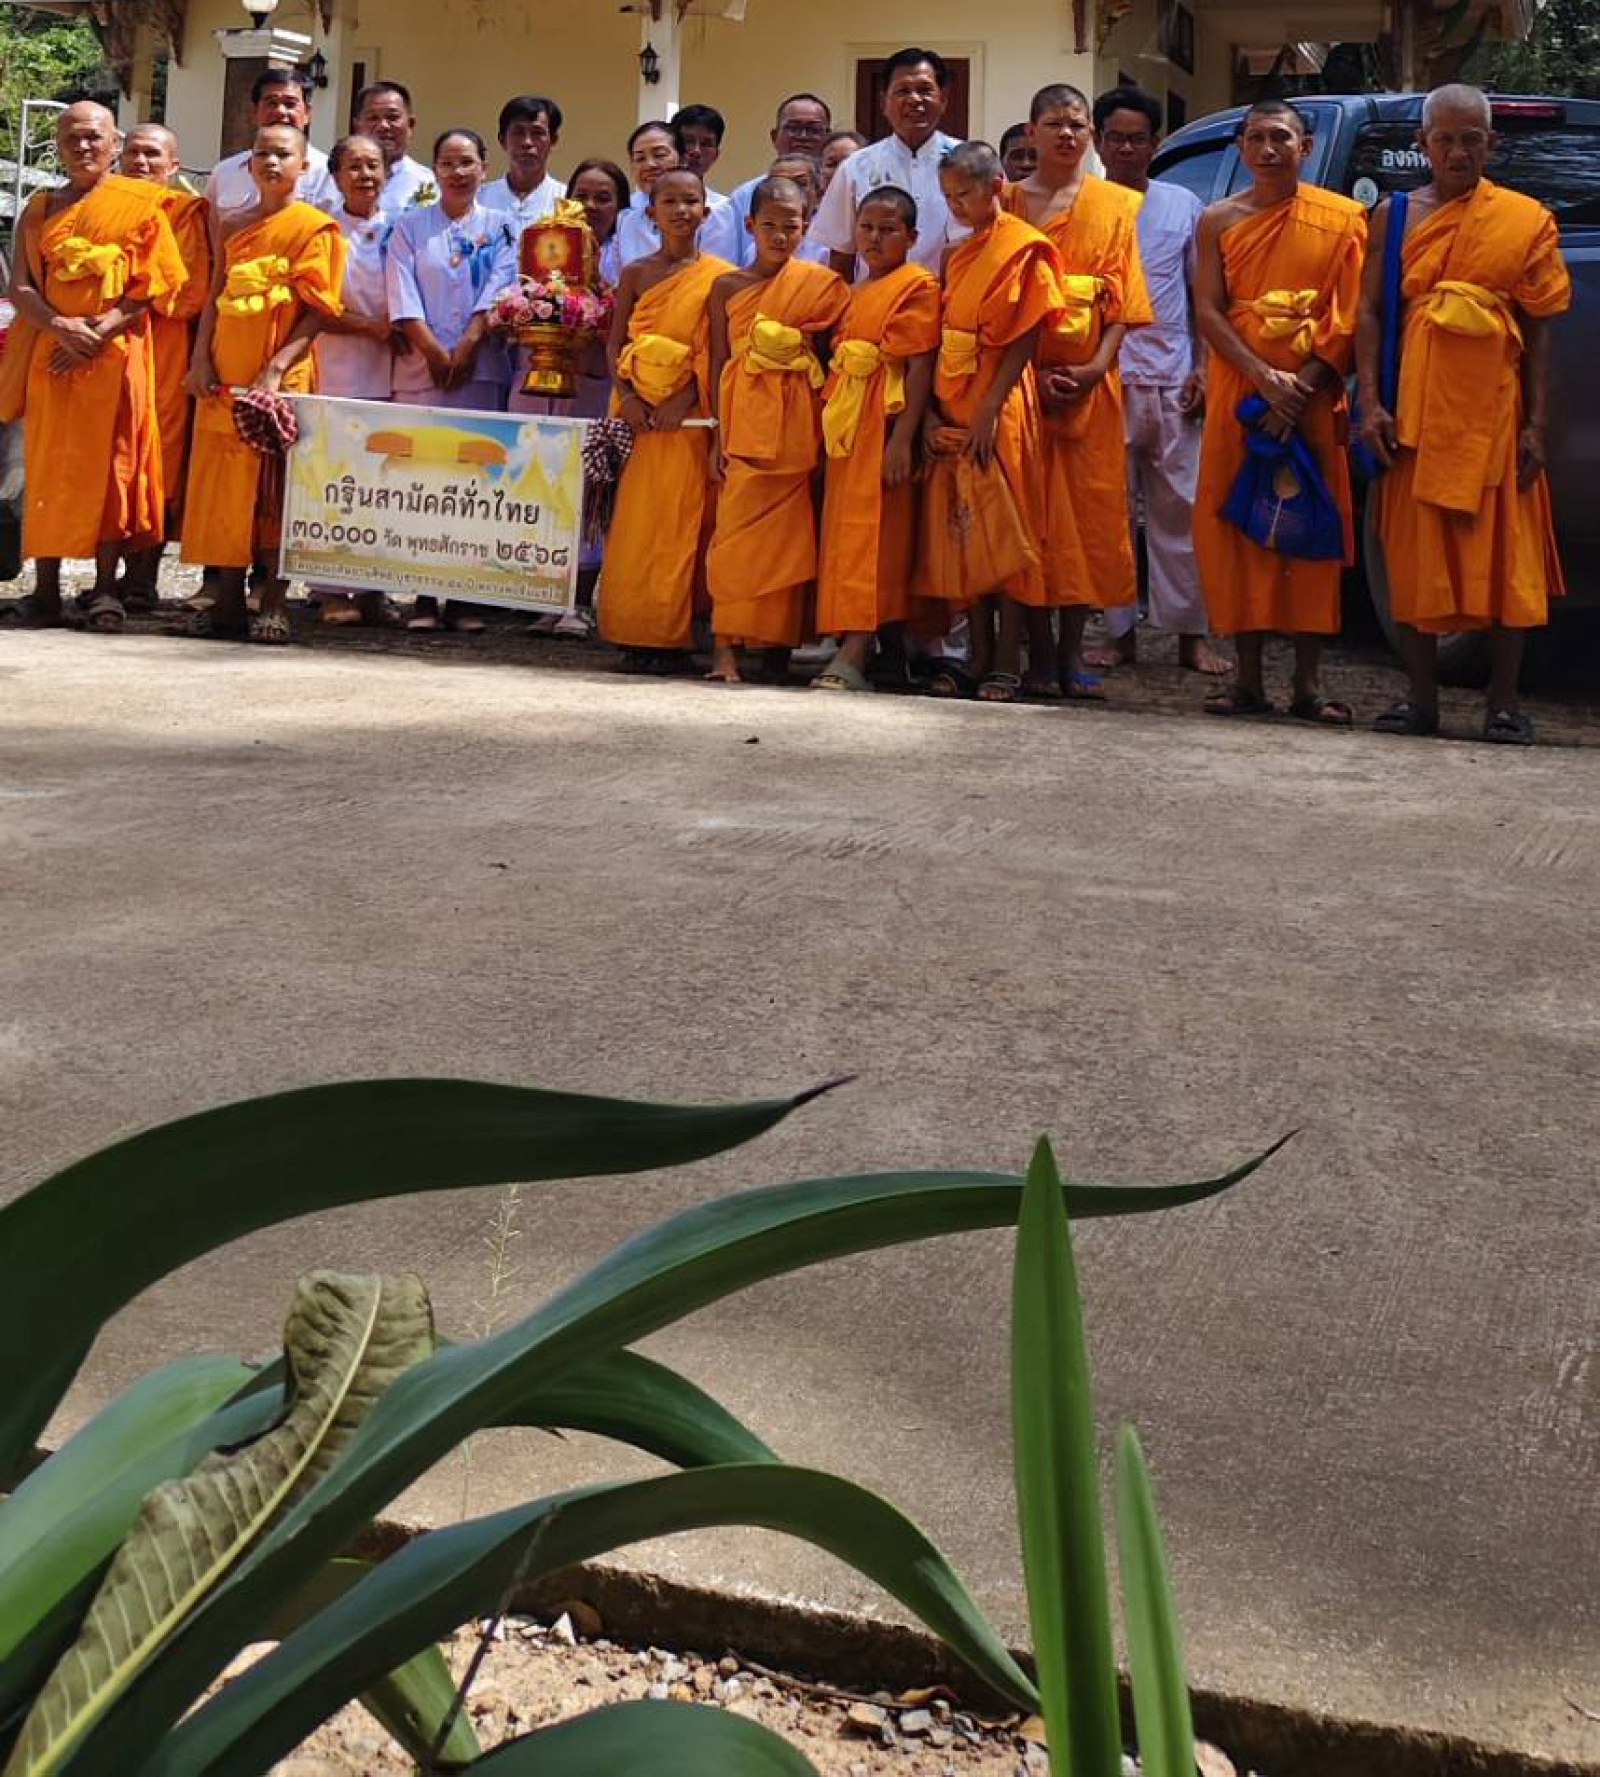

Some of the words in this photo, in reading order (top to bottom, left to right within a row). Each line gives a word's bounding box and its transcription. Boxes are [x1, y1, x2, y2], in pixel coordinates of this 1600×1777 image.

[324, 474, 540, 525] กฐินสามัคคีทั่วไทย
[292, 519, 377, 545] ๓๐,๐๐๐
[383, 527, 402, 549] วัด
[407, 532, 490, 558] พุทธศักราช
[496, 538, 569, 566] ๒๕๖๘
